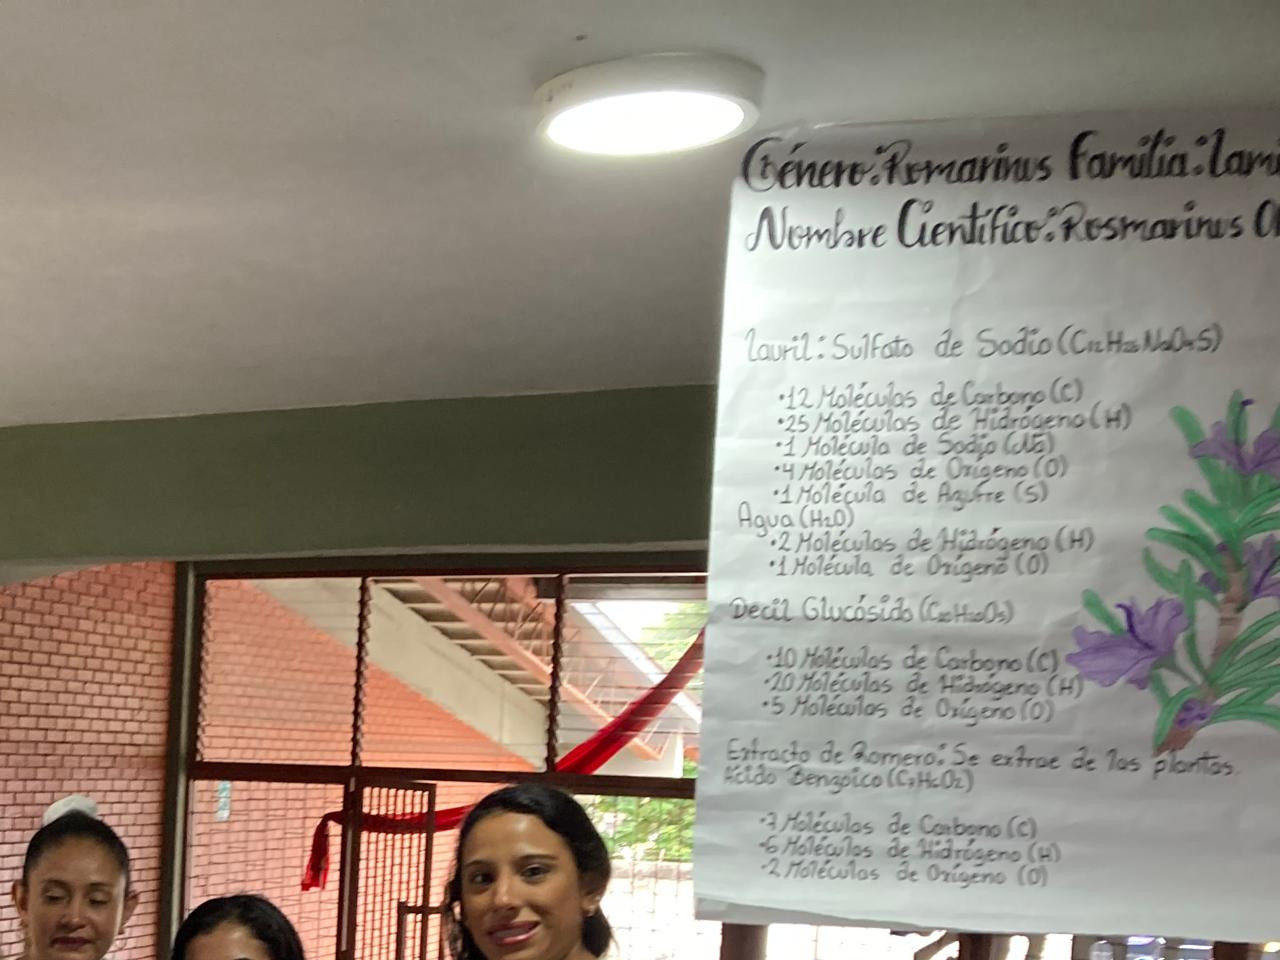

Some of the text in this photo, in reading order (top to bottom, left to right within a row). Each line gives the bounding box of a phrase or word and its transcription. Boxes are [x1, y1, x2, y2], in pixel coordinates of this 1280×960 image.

[745, 205, 888, 252] Nombre
[832, 331, 914, 361] Sulfato
[933, 327, 963, 358] de
[976, 326, 1052, 358] Sodio
[930, 380, 958, 406] de
[931, 406, 962, 431] de
[903, 433, 928, 456] de
[910, 457, 937, 480] de
[902, 480, 928, 504] de
[738, 501, 795, 538] Agua
[906, 528, 933, 552] de
[889, 554, 916, 576] de
[903, 643, 929, 670] de
[906, 671, 929, 694] de
[901, 695, 924, 718] de
[726, 737, 812, 763] Extracto
[819, 739, 845, 764] de
[952, 741, 983, 767] Se
[990, 745, 1062, 770] extrae
[1070, 745, 1097, 772] de
[1106, 748, 1143, 772] las
[887, 811, 912, 836] de
[887, 836, 911, 859] de
[896, 859, 919, 882] de
